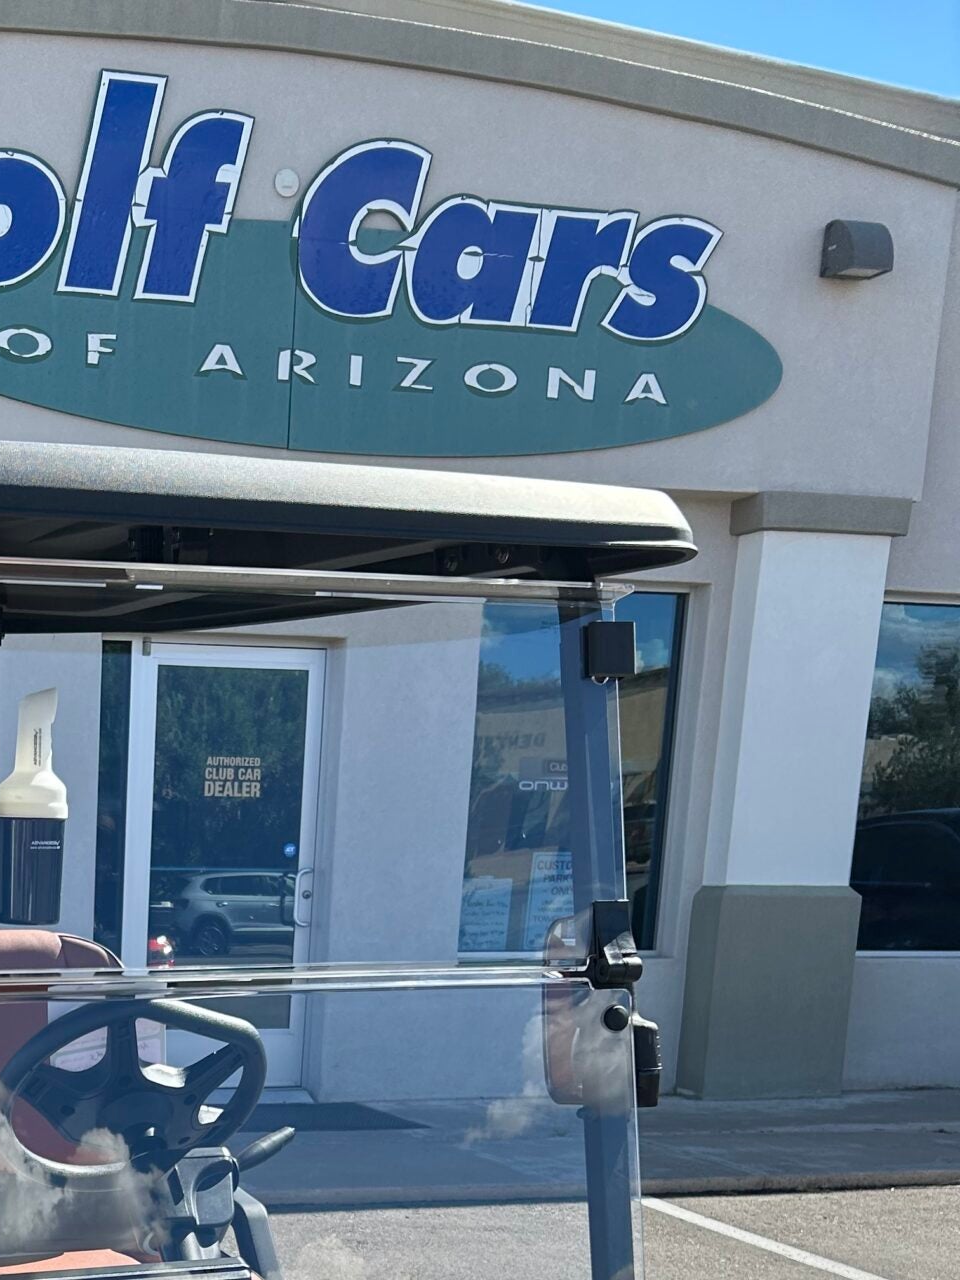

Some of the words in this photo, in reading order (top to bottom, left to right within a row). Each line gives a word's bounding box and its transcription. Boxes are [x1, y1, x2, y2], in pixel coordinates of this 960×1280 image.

[294, 138, 724, 342] Cars
[199, 343, 668, 405] ARIZONA
[206, 756, 261, 767] AUTHORIZED
[205, 767, 235, 780] CLUB
[238, 768, 261, 781] CAR
[203, 781, 261, 798] DEALER
